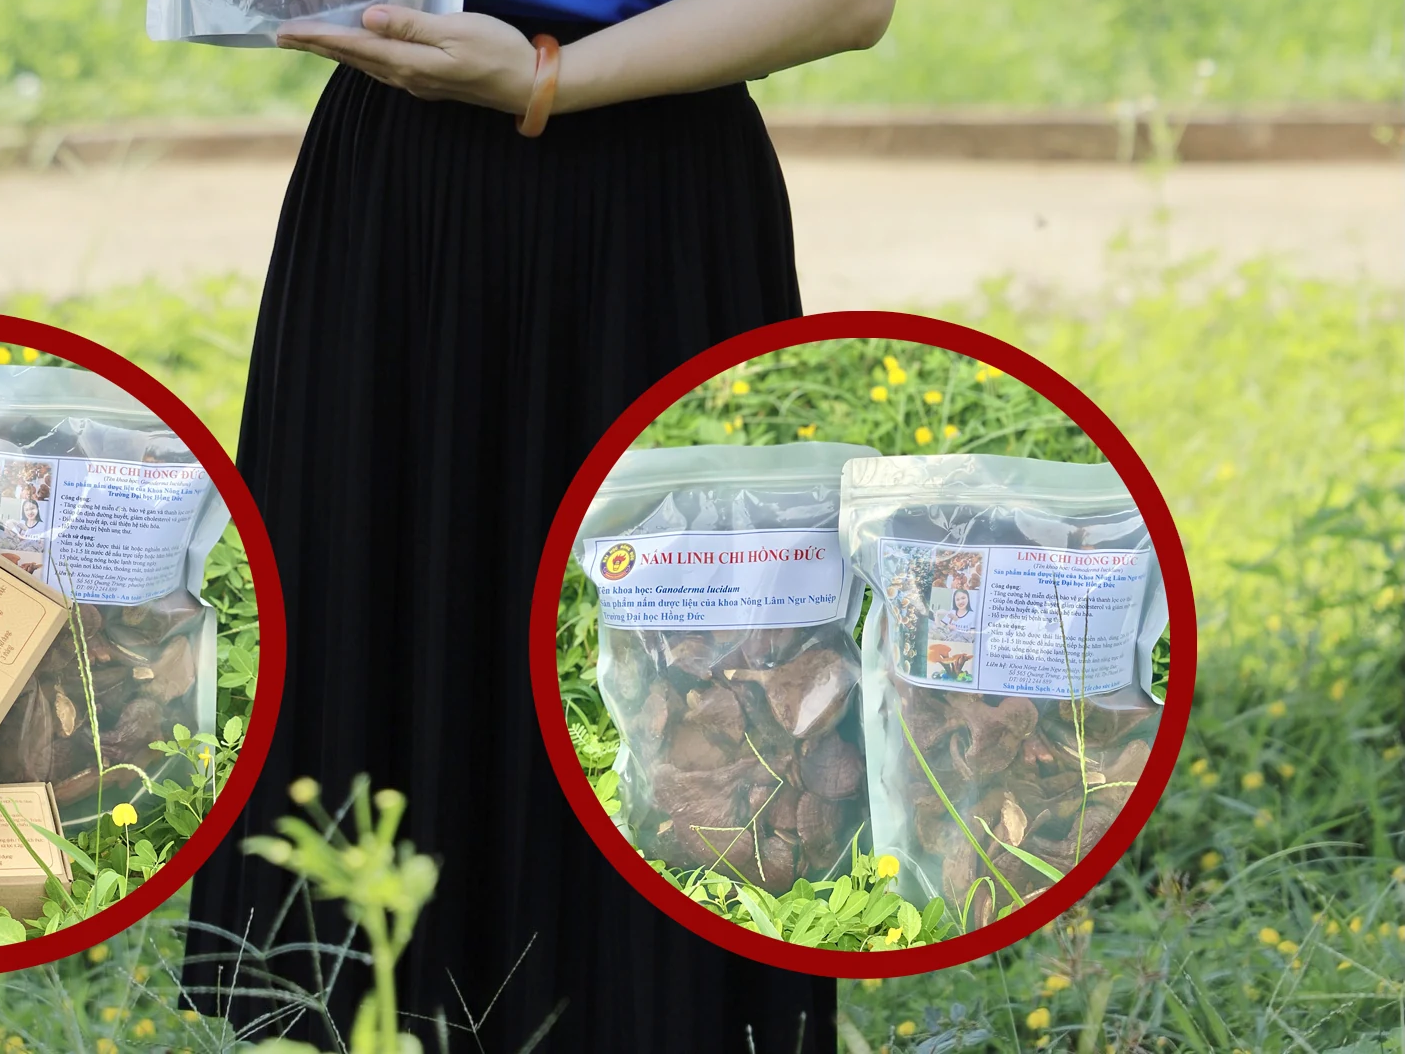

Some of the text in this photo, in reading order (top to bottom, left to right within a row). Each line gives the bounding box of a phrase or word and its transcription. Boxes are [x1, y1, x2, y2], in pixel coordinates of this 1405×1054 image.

[88, 464, 117, 474] LINH
[120, 466, 140, 477] CHI
[677, 552, 714, 565] LINH
[718, 551, 744, 565] CHI
[793, 546, 826, 560] ĐỨC
[1017, 552, 1046, 562] LINH
[1049, 553, 1072, 564] CHI
[612, 586, 633, 594] khoa
[636, 586, 653, 596] học:
[656, 585, 704, 594] Ganoderma
[706, 584, 740, 594] lucidum
[612, 596, 634, 609] phẩm
[636, 596, 656, 608] nấm
[682, 598, 698, 609] liệu
[700, 598, 716, 607] của
[718, 598, 738, 607] khoa
[740, 596, 762, 608] Nông
[764, 596, 785, 606] Lâm
[788, 596, 806, 606] Ngư
[808, 594, 836, 605] Nghiệp
[626, 612, 641, 622] Đại
[643, 612, 658, 622] học
[661, 610, 685, 622] Hồng
[687, 612, 706, 621] Đức
